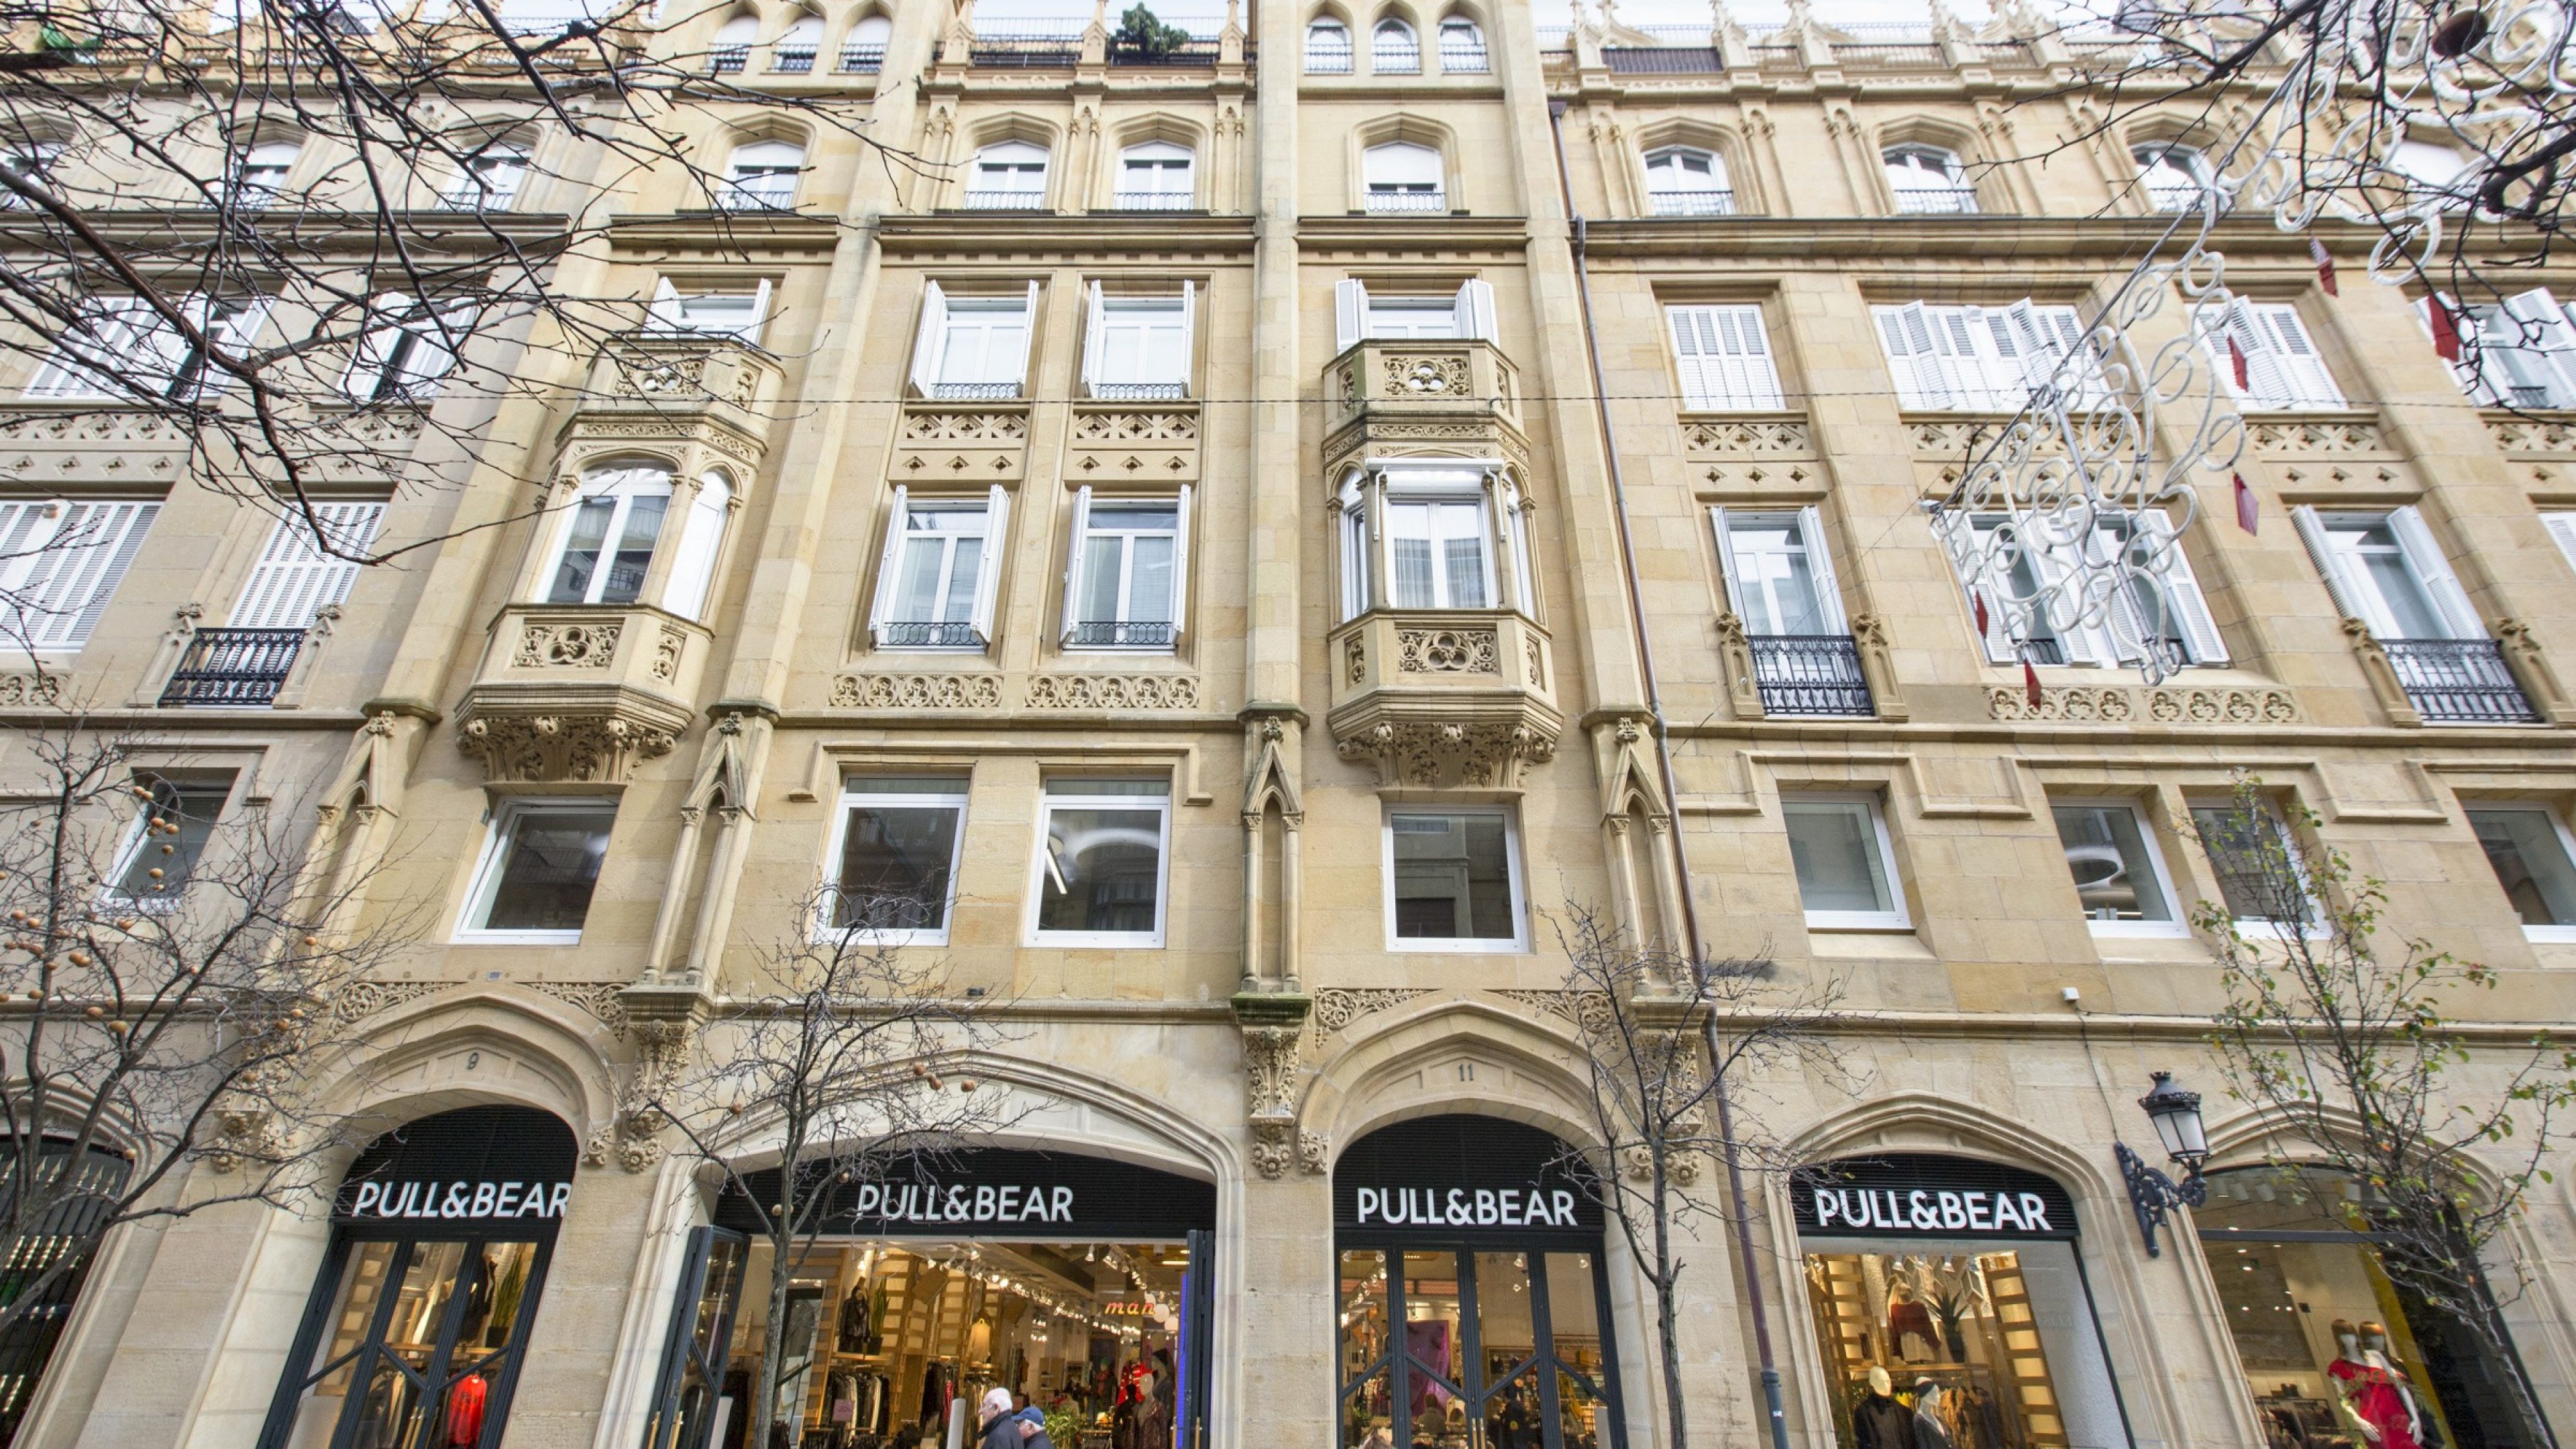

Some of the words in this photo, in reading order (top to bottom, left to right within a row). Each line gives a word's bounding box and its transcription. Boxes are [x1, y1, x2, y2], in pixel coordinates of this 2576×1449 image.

[466, 1051, 479, 1071] 9
[1459, 1063, 1474, 1081] 11
[351, 1181, 572, 1219] PULL&BEAR
[857, 1184, 1073, 1222] PULL&BEAR
[1357, 1187, 1578, 1226] PULL&BEAR
[1814, 1189, 2053, 1230] PULL&BEAR
[1104, 1301, 1155, 1315] man
